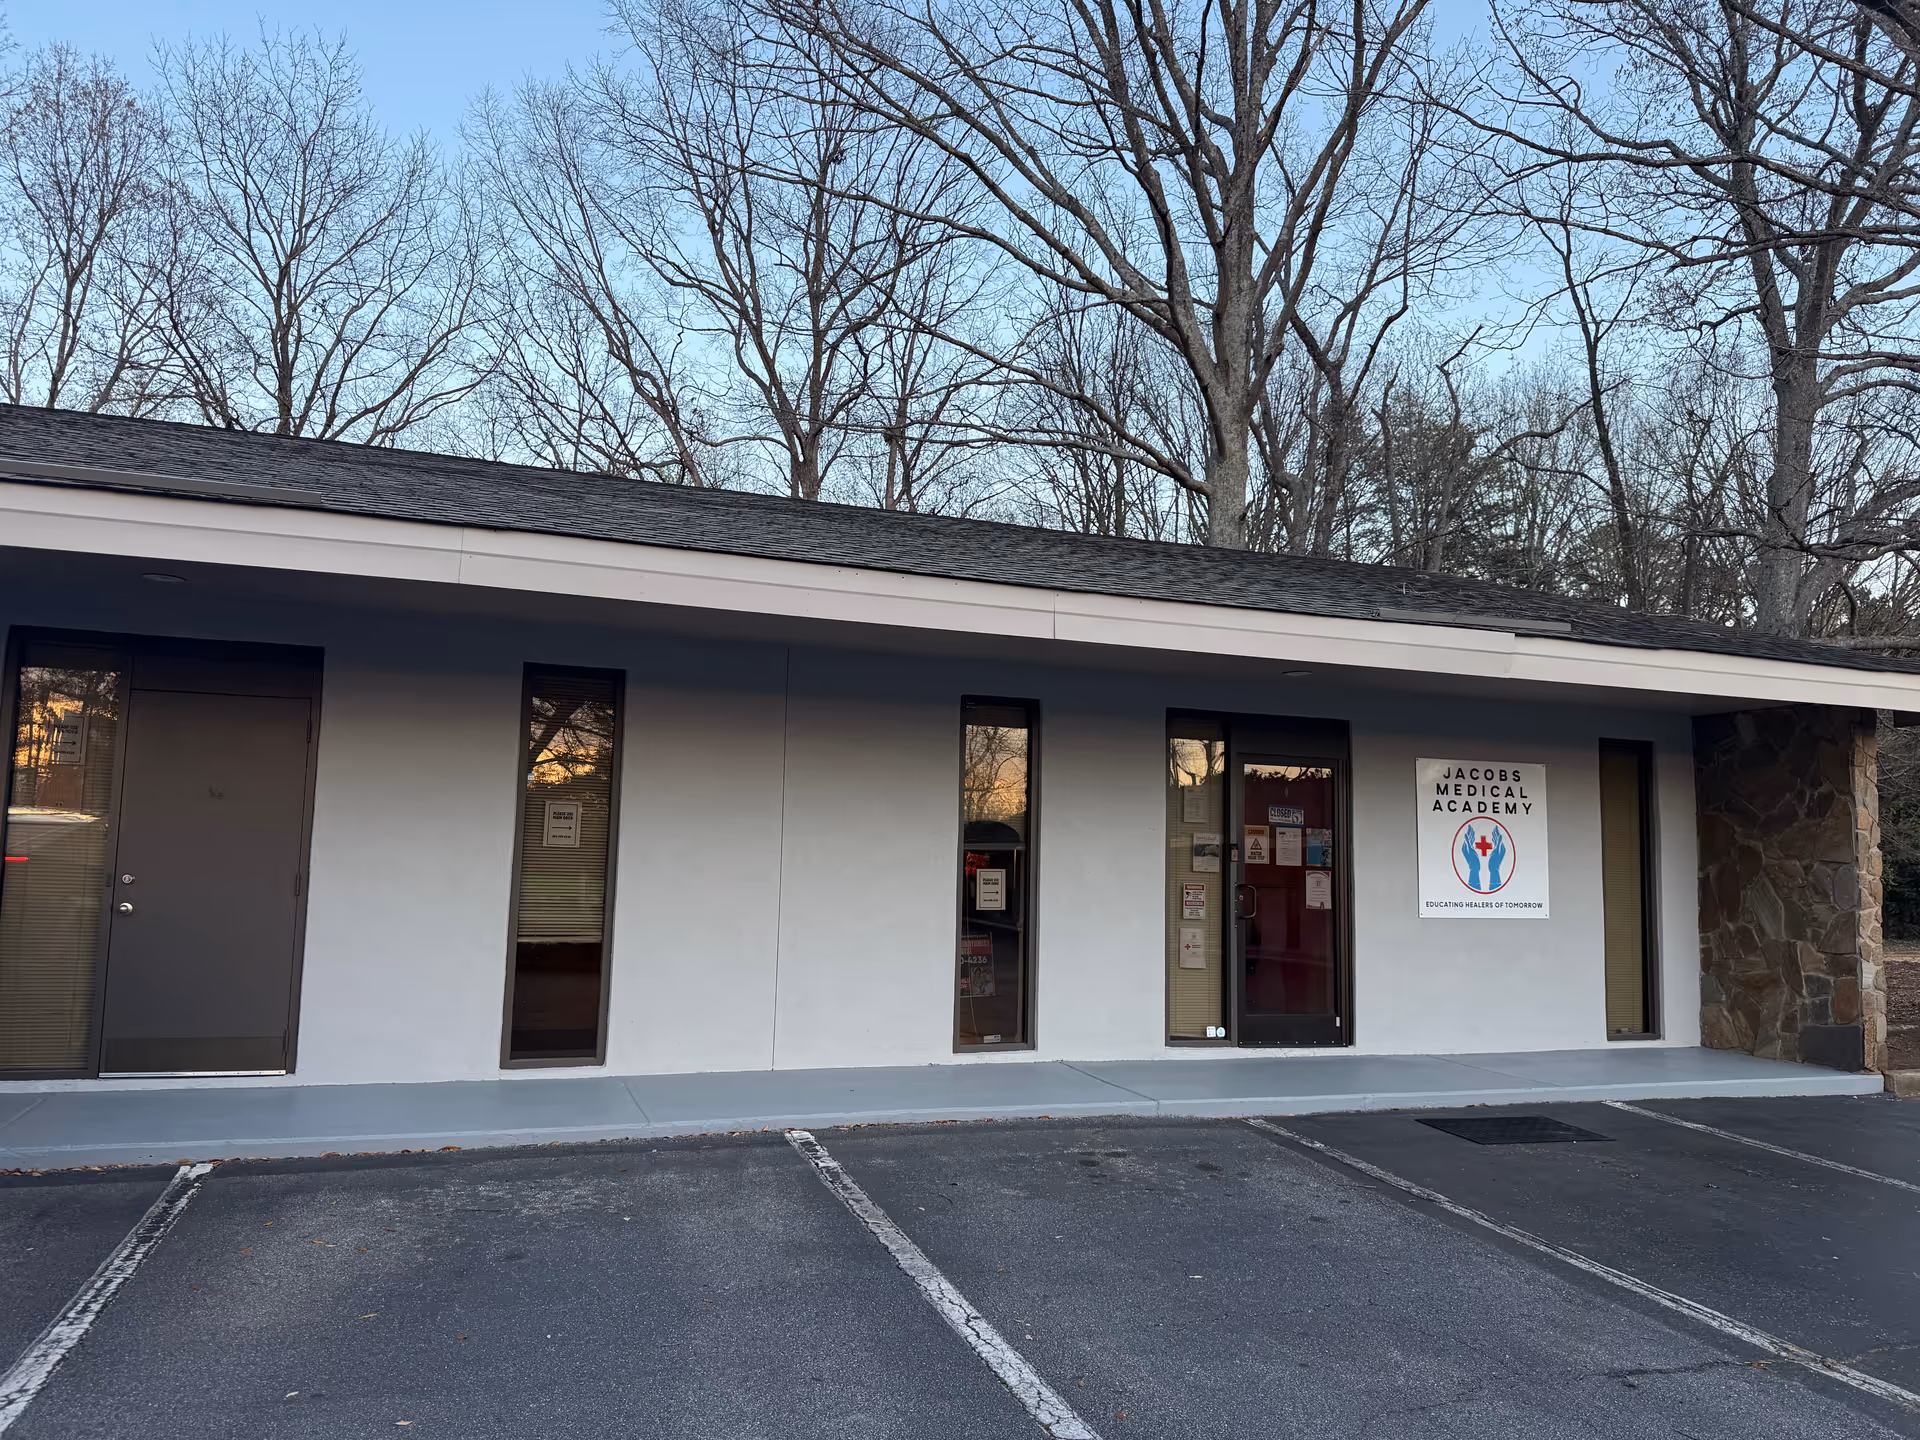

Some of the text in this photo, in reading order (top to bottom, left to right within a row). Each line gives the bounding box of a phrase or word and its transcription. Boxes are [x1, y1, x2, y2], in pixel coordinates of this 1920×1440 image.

[1443, 767, 1521, 782] JACOBS
[1436, 783, 1528, 799] MEDICAL
[1270, 807, 1291, 818] CLOSED
[1432, 799, 1532, 815] ACADEMY
[1425, 900, 1543, 909] EDUCATING HEALERS OF TOMORROW
